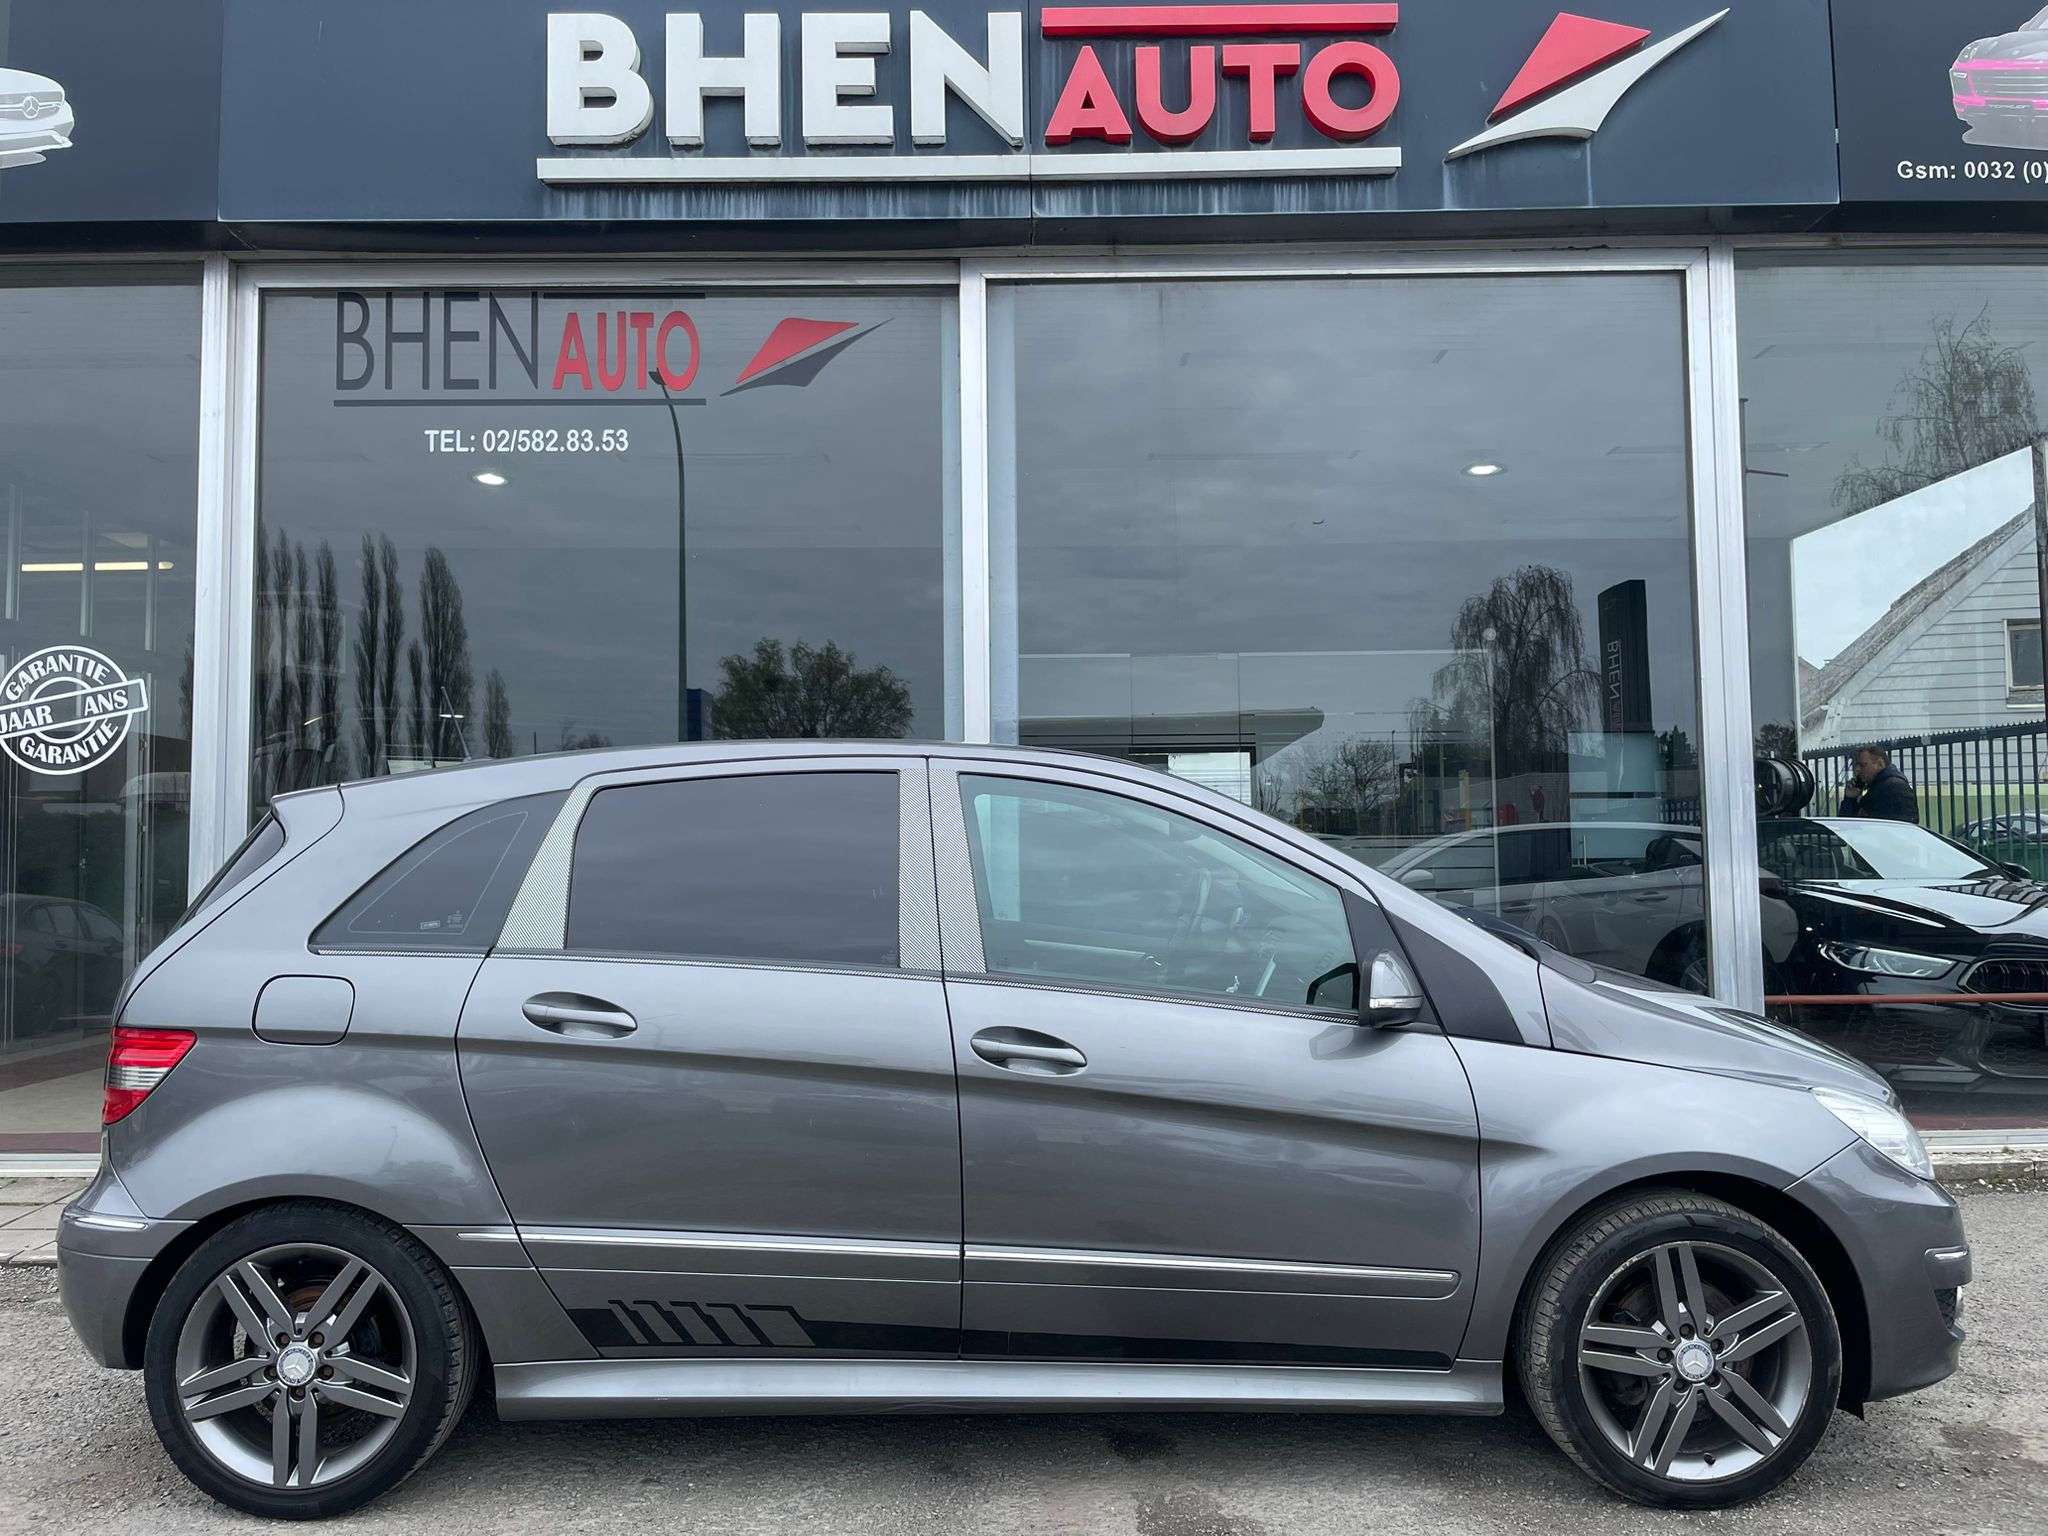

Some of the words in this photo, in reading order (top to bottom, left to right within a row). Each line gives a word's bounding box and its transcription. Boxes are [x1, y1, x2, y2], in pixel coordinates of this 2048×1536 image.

[547, 10, 1024, 146] BHEN
[1045, 41, 1401, 145] AUTO
[1897, 161, 1956, 179] Gsm:
[1964, 161, 2015, 179] 0032
[336, 291, 539, 390] BHEN
[552, 311, 701, 391] AUTO
[424, 429, 475, 452] TEL:
[482, 429, 629, 452] 02/582.83.53
[6, 654, 111, 701] GARANTIE
[0, 705, 54, 734] JAAR
[84, 689, 129, 716] ANS
[20, 719, 119, 764] GARANTIE
